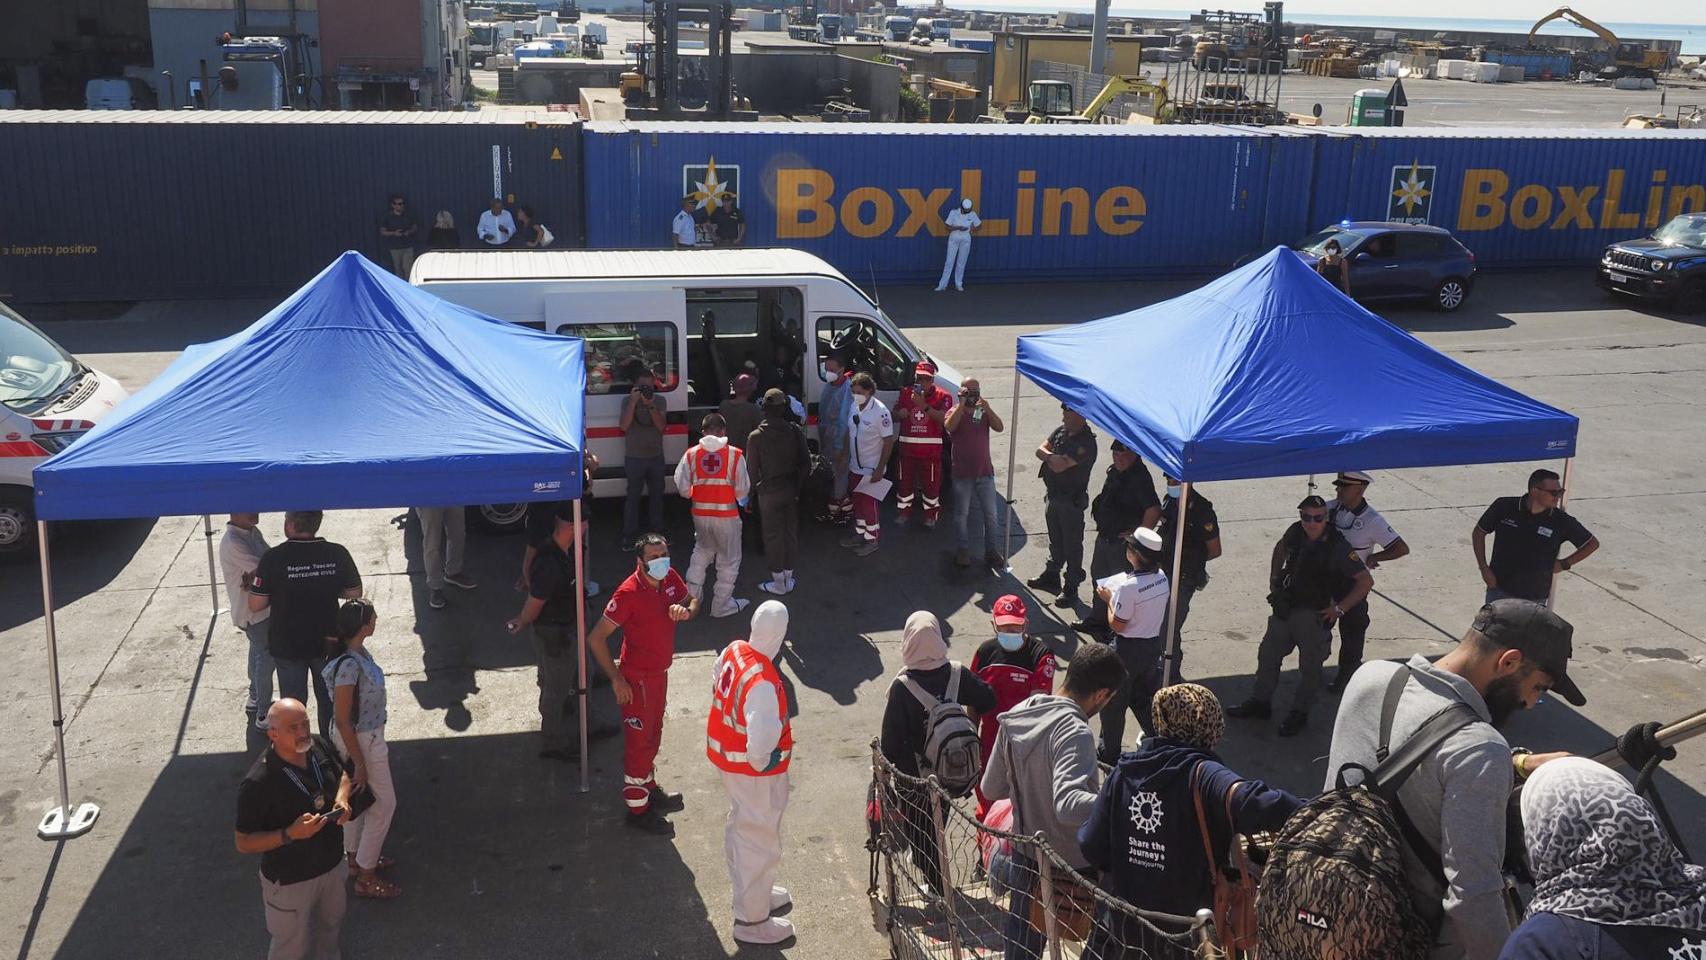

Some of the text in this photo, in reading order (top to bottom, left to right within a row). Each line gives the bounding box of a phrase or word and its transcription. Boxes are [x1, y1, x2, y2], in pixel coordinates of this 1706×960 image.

[776, 169, 1147, 239] BoxLine
[12, 244, 53, 257] impatto
[56, 243, 97, 256] positivo
[1129, 836, 1165, 852] Share the
[1128, 846, 1160, 862] Journey
[1298, 910, 1328, 929] FILA
